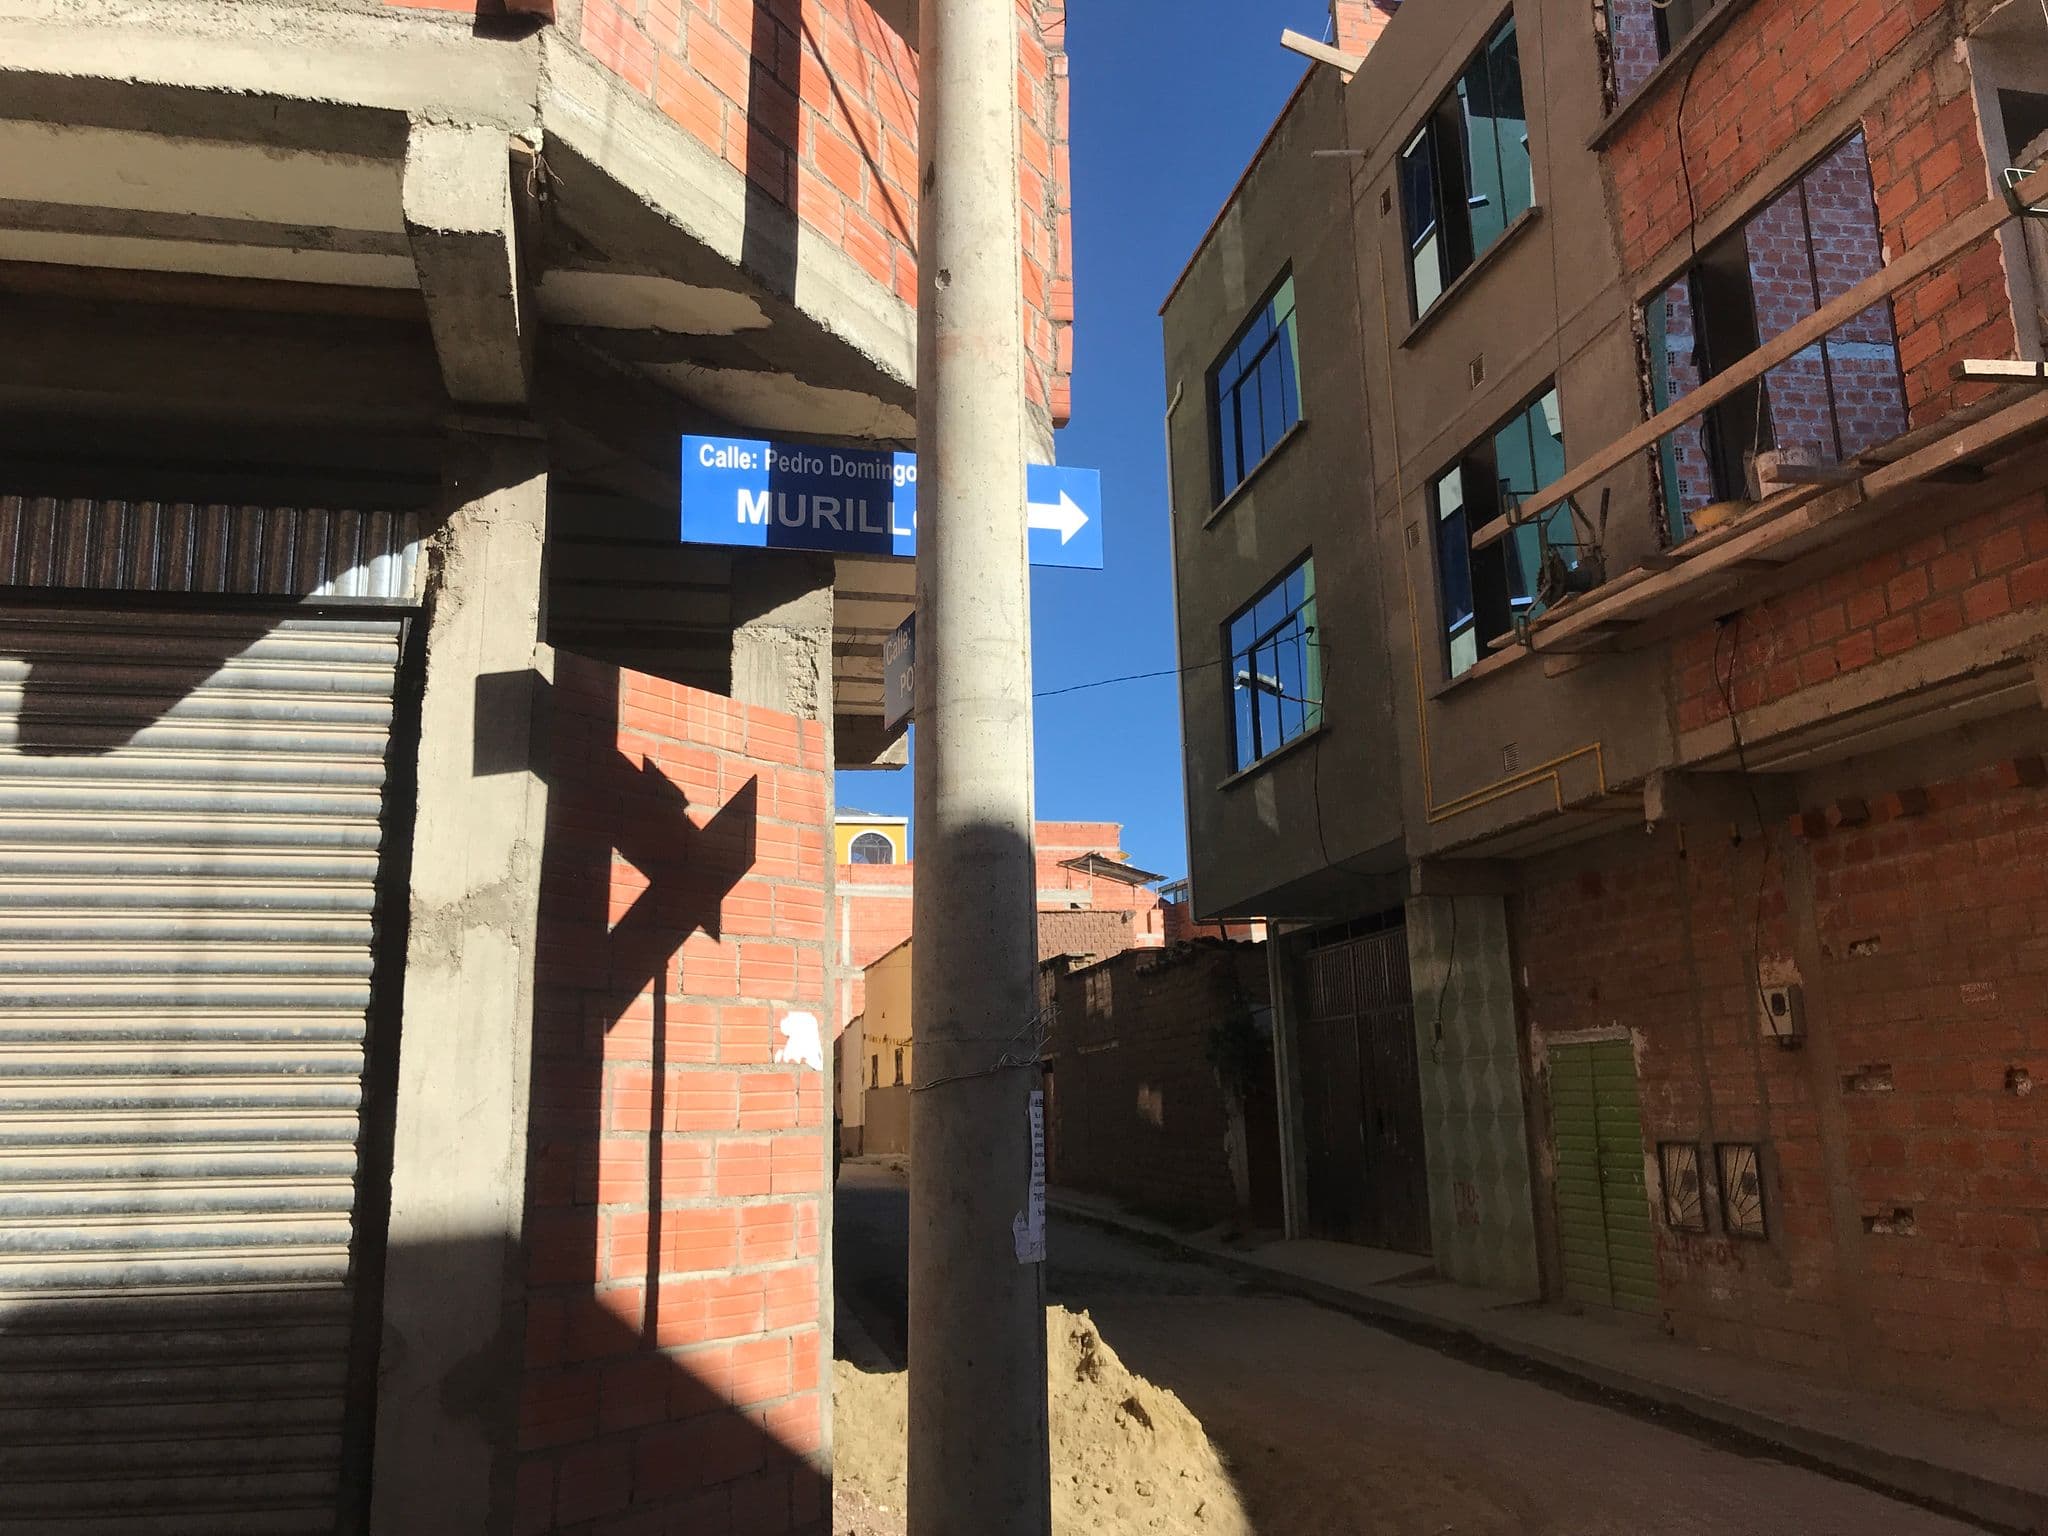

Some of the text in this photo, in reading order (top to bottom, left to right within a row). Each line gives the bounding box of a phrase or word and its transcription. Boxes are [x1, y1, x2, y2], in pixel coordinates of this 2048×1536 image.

[699, 443, 917, 487] Calle: Pedro Domingo
[737, 488, 917, 537] MURILL
[886, 628, 911, 666] Calle:
[900, 662, 916, 698] PO
